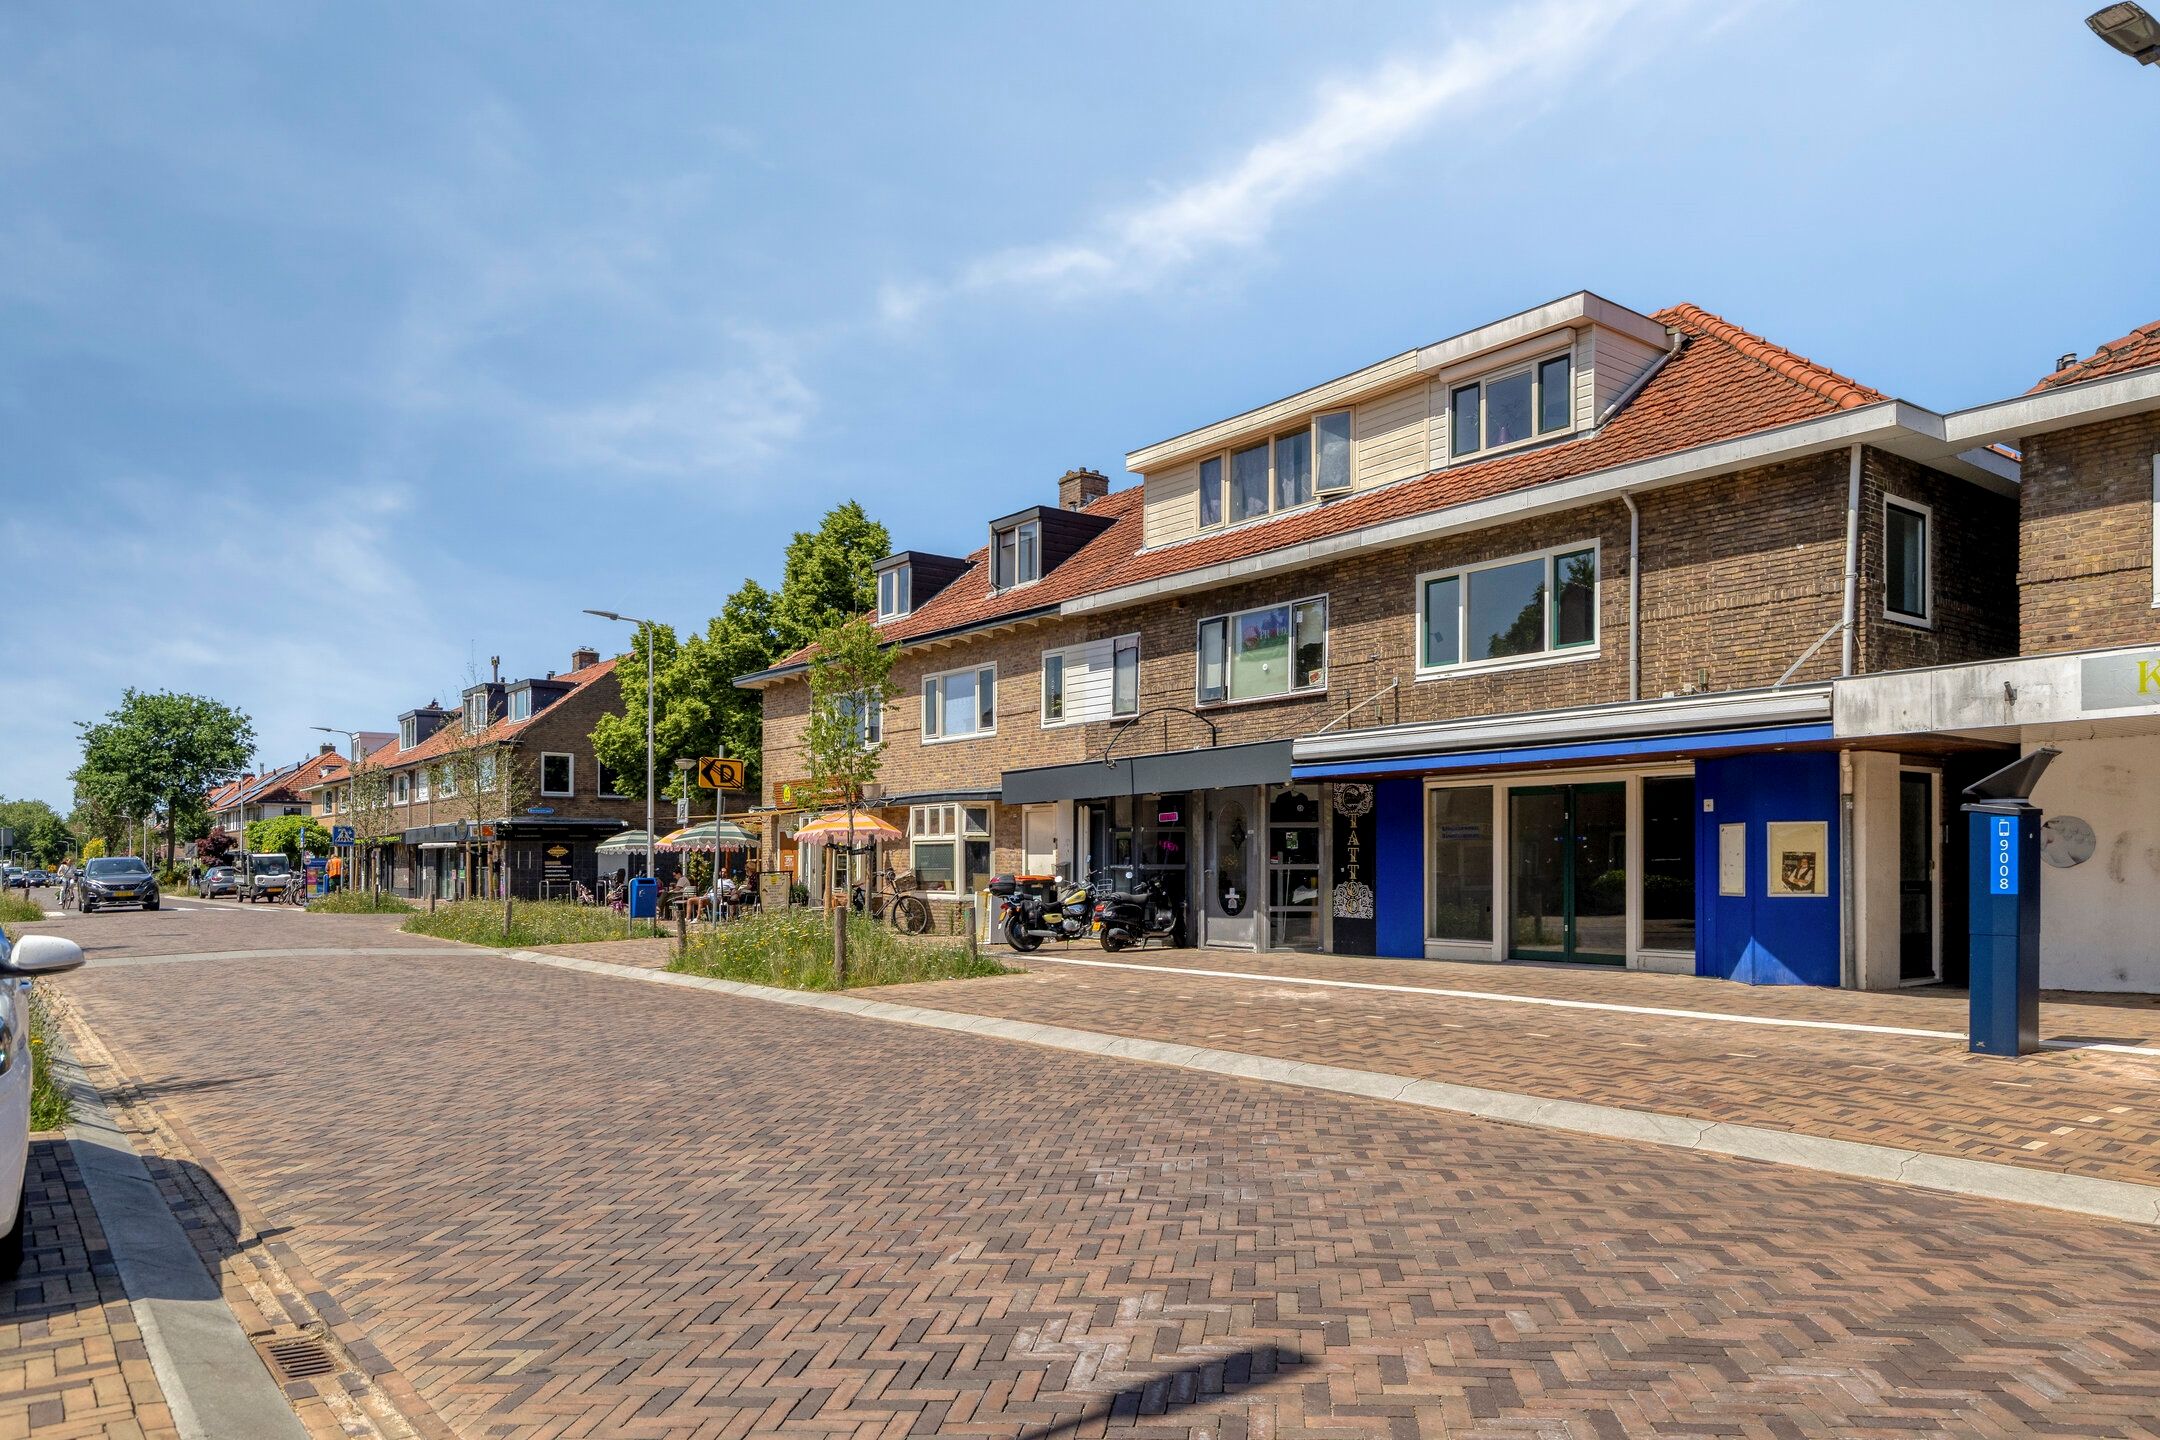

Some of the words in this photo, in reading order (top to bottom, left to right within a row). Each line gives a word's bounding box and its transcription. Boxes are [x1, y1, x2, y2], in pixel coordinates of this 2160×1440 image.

[720, 764, 735, 783] D
[1346, 813, 1360, 914] TATTOO
[2000, 840, 2008, 889] 9008
